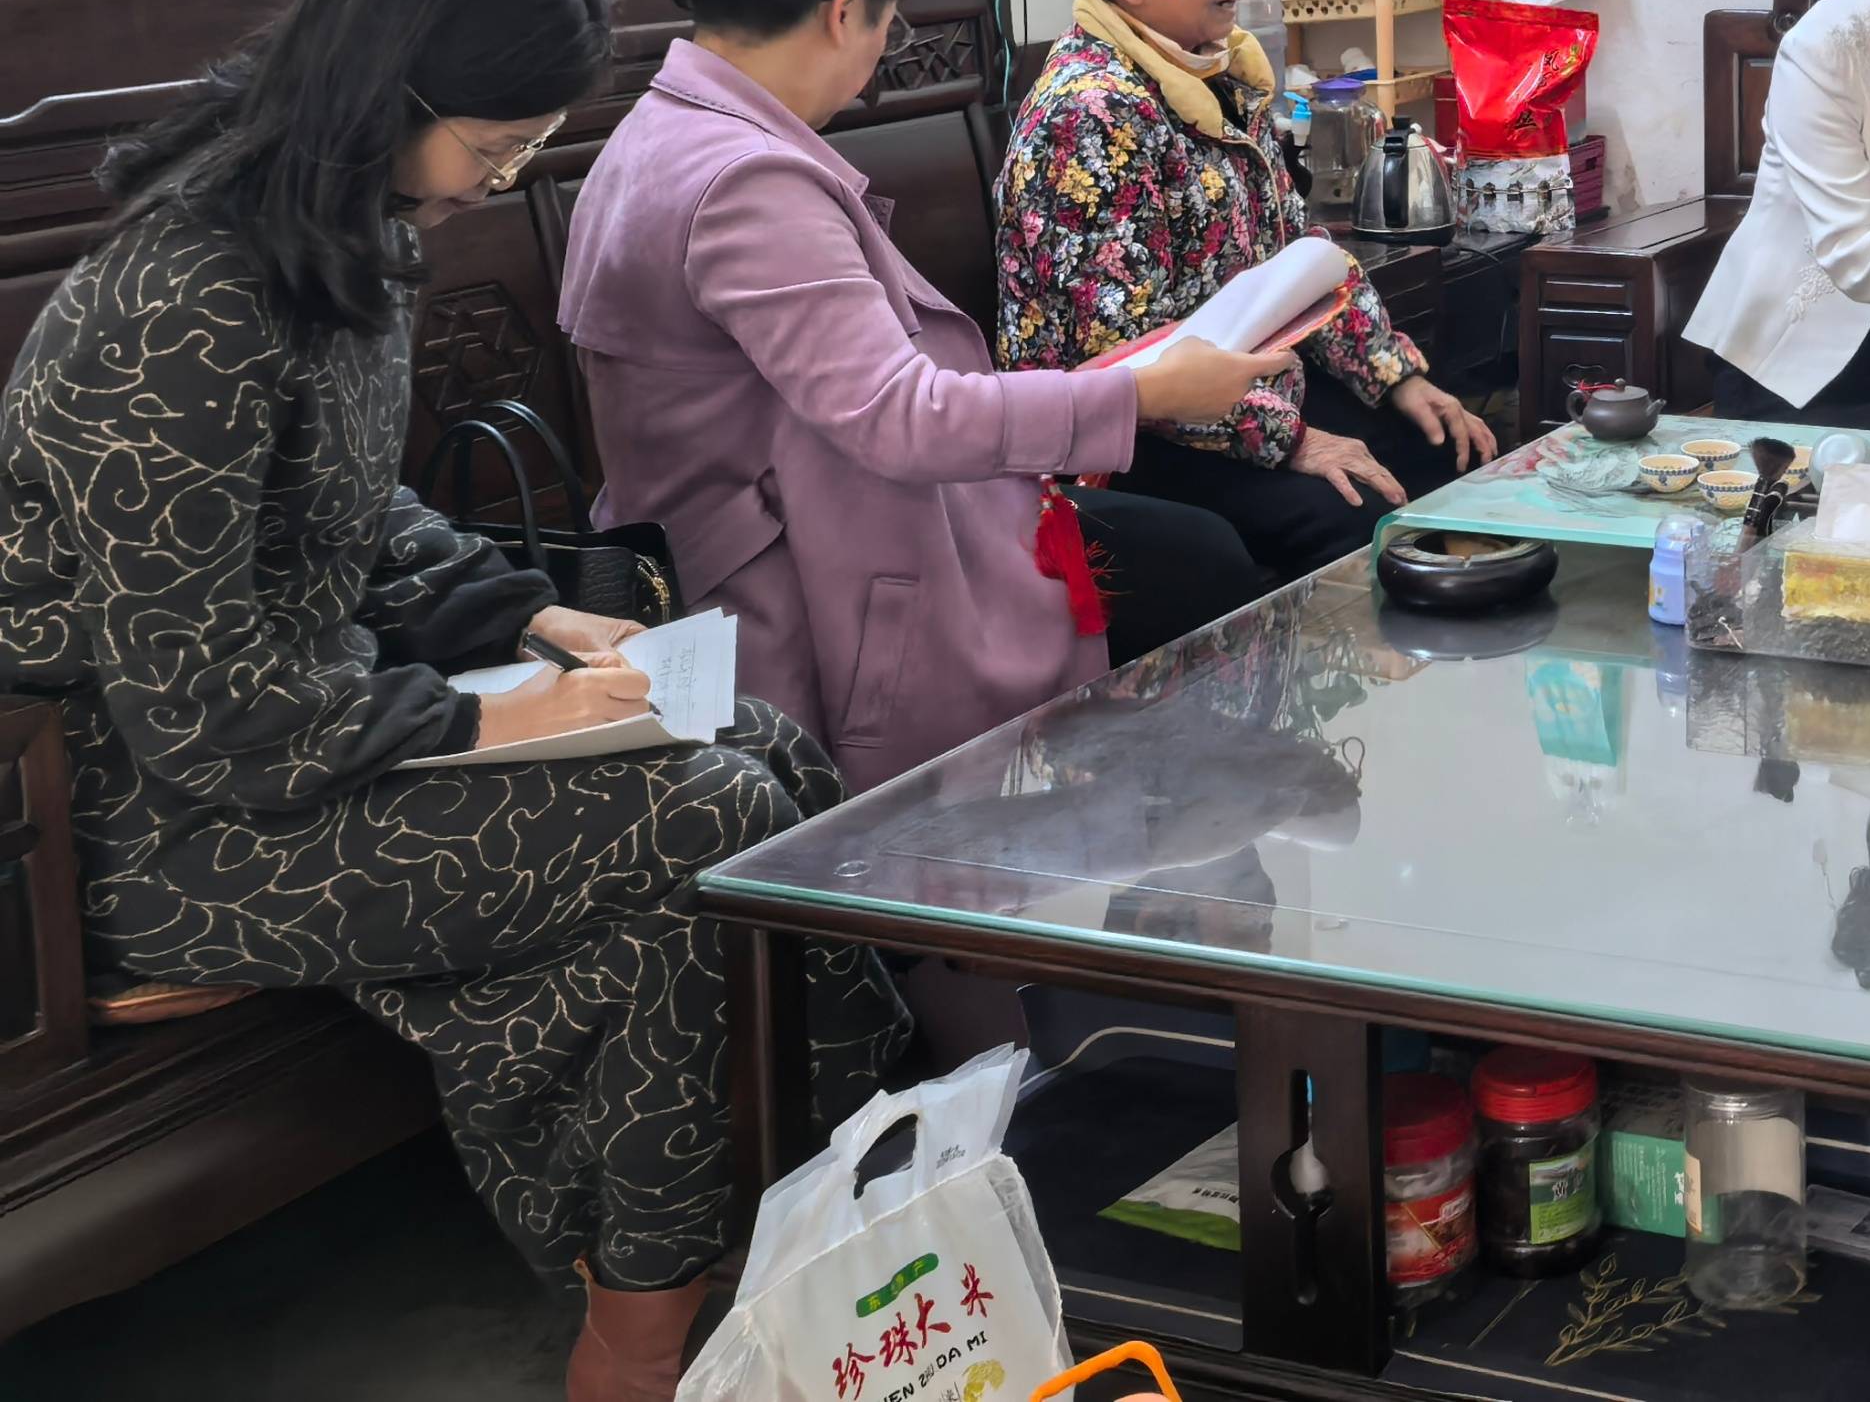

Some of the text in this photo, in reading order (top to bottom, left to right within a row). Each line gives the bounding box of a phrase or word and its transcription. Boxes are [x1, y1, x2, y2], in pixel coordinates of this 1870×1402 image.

[832, 1263, 994, 1401] 珍珠大米
[936, 1347, 961, 1370] DA
[966, 1330, 988, 1352] MI
